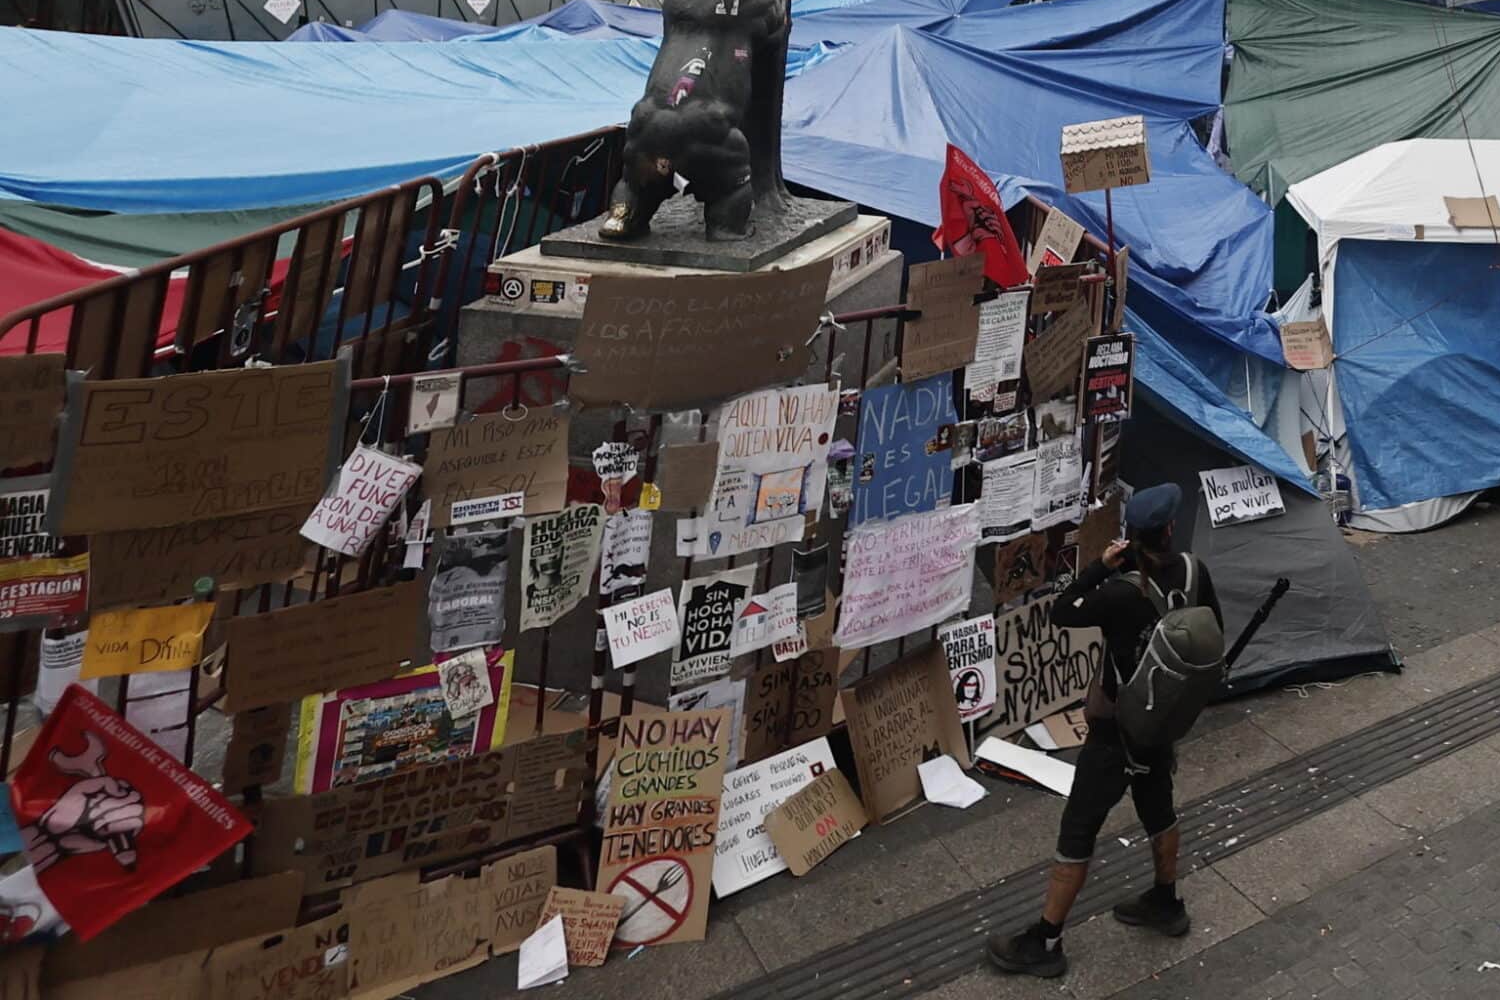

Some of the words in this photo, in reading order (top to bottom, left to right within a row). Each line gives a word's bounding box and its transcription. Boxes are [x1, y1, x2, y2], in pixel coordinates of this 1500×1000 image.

[778, 394, 798, 425] NO
[860, 381, 957, 453] NADIE
[445, 426, 470, 450] MI
[482, 420, 513, 443] PISO
[723, 426, 770, 458] QUIEN
[776, 428, 813, 455] VIVA
[439, 453, 511, 475] ASEQUIBLE
[885, 442, 911, 468] ES
[350, 454, 416, 489] DIVER
[348, 479, 402, 510] FUNCI
[1207, 476, 1229, 500] Nos
[1231, 472, 1274, 494] multan
[531, 505, 601, 536] HUELGA
[1215, 502, 1238, 521] por
[327, 515, 358, 535] UNA
[530, 517, 598, 546] EDUCATIVA
[436, 594, 495, 612] LABORAL
[706, 588, 730, 602] SIN
[614, 611, 627, 625] MI
[627, 615, 646, 631] NO
[688, 601, 735, 622] HOGA
[686, 619, 711, 637] NO
[712, 616, 734, 632] HA
[980, 619, 993, 632] PAZ
[95, 641, 129, 655] VIDA
[613, 634, 631, 649] TU
[775, 639, 805, 657] BASTA
[946, 636, 977, 658] PARA
[978, 632, 988, 646] EL
[672, 664, 686, 676] LA
[689, 654, 730, 672] VIVIEN
[947, 645, 994, 670] ENTISMO
[1005, 630, 1070, 684] SIDO
[759, 671, 792, 698] SIN
[1004, 641, 1104, 726] NGAÑADO
[752, 703, 781, 734] SIN
[620, 719, 665, 749] NO
[670, 715, 722, 746] HAY
[617, 746, 719, 778] CUCHILLOS
[158, 758, 238, 831] Estudiantes
[622, 775, 697, 799] GRANDES
[723, 788, 763, 811] LUGARES
[610, 803, 646, 827] HAY
[650, 799, 715, 822] GRANDES
[605, 822, 716, 865] TENEDORES
[508, 862, 526, 881] NO
[494, 881, 545, 905] VOTAR
[314, 923, 350, 949] NO
[261, 953, 326, 990] VEND
